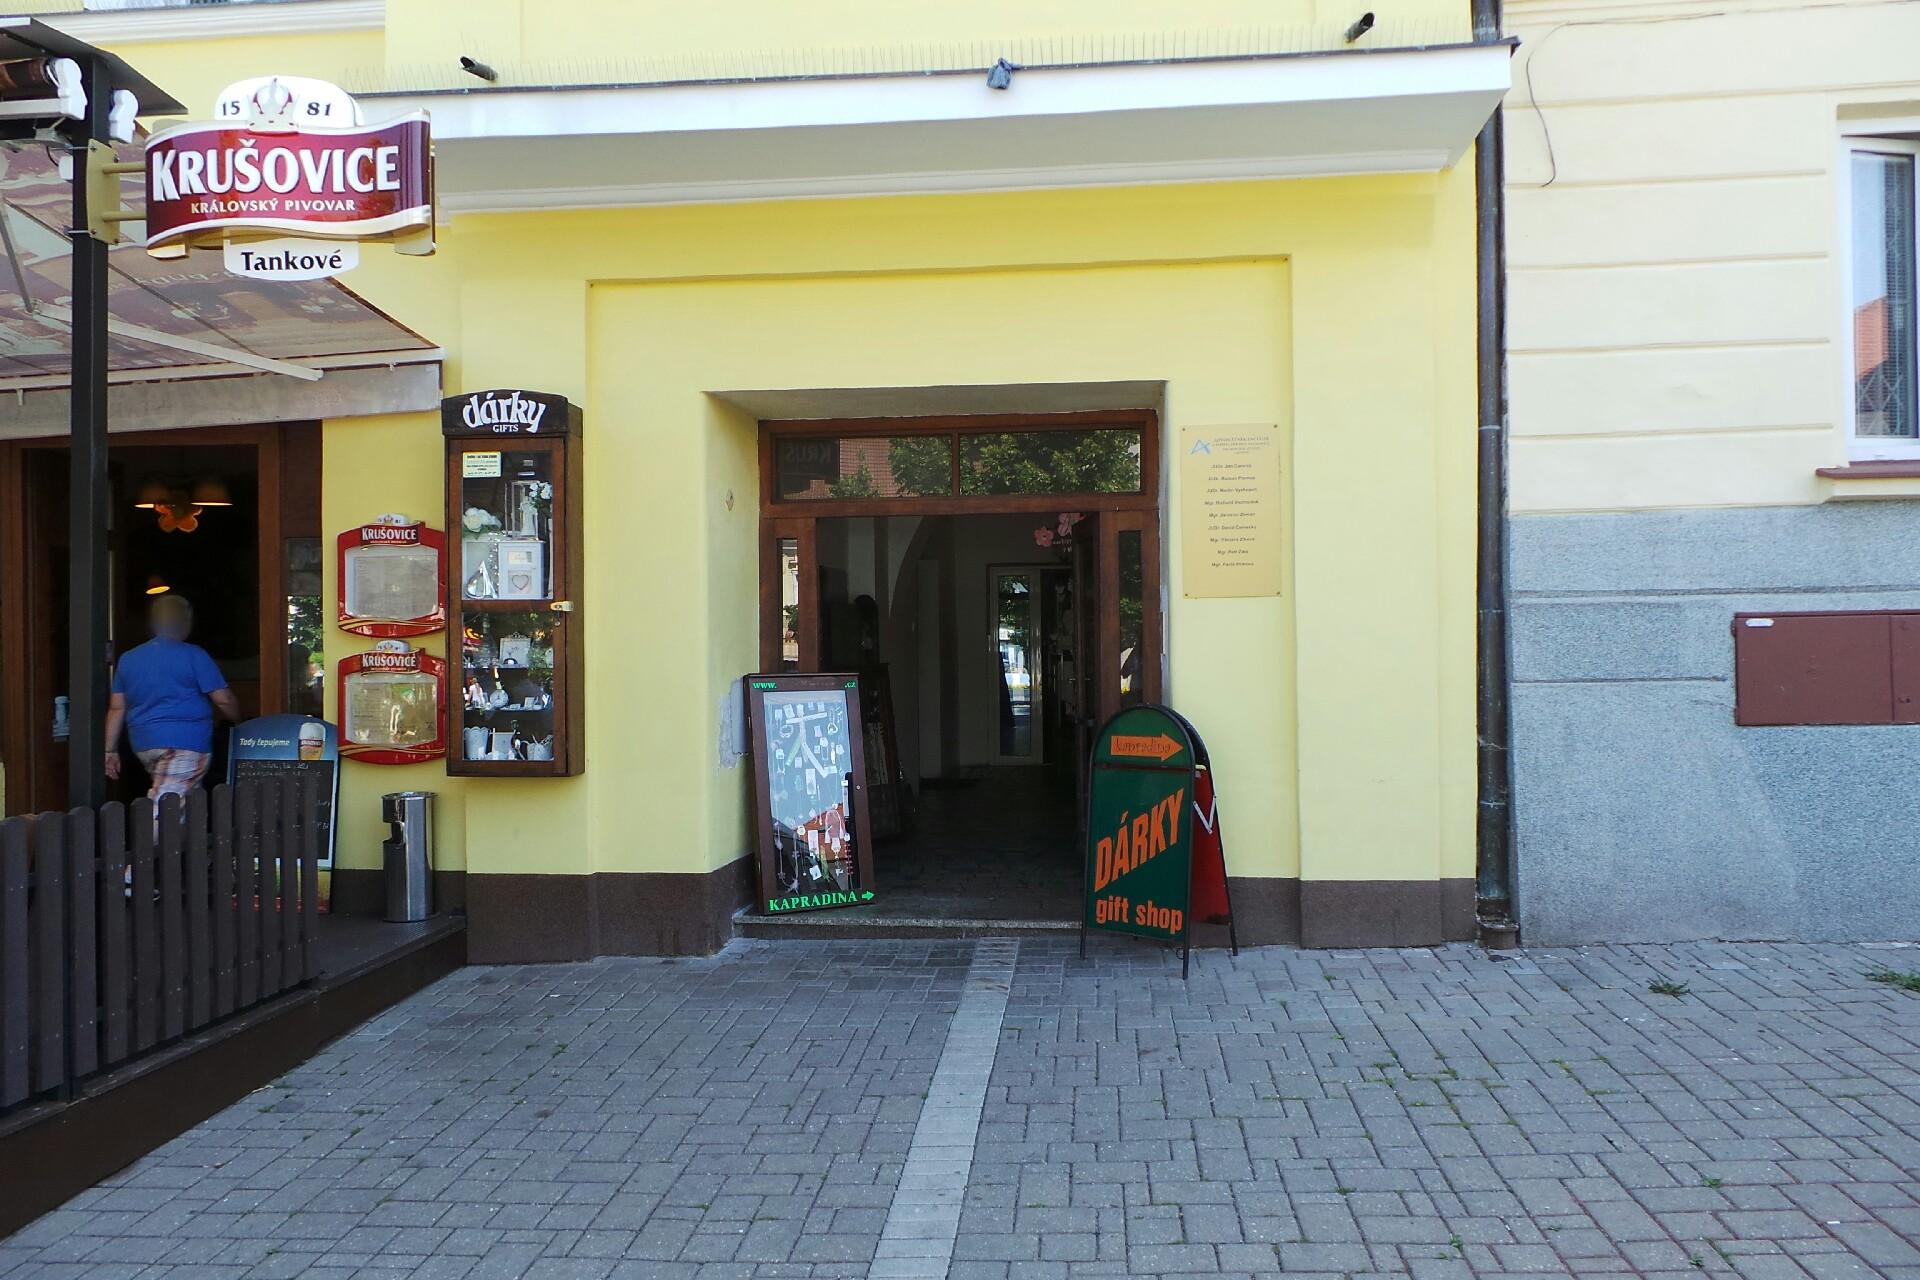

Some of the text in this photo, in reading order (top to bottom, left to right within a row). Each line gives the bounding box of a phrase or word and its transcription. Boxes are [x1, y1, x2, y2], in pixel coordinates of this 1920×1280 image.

[222, 101, 332, 116] 15 81
[152, 138, 401, 202] KRUŠOVICE
[191, 197, 356, 214] KRÁLOVSKÝ PIVOVAR
[241, 249, 343, 271] Tankové
[462, 391, 546, 433] dárky
[492, 424, 519, 432] GIFTS
[362, 526, 417, 541] KRUŠOVICE
[844, 681, 857, 689] .cz
[1094, 787, 1184, 893] DÁRKY
[768, 890, 859, 911] KAPRADINA
[1095, 895, 1183, 935] gift shop
